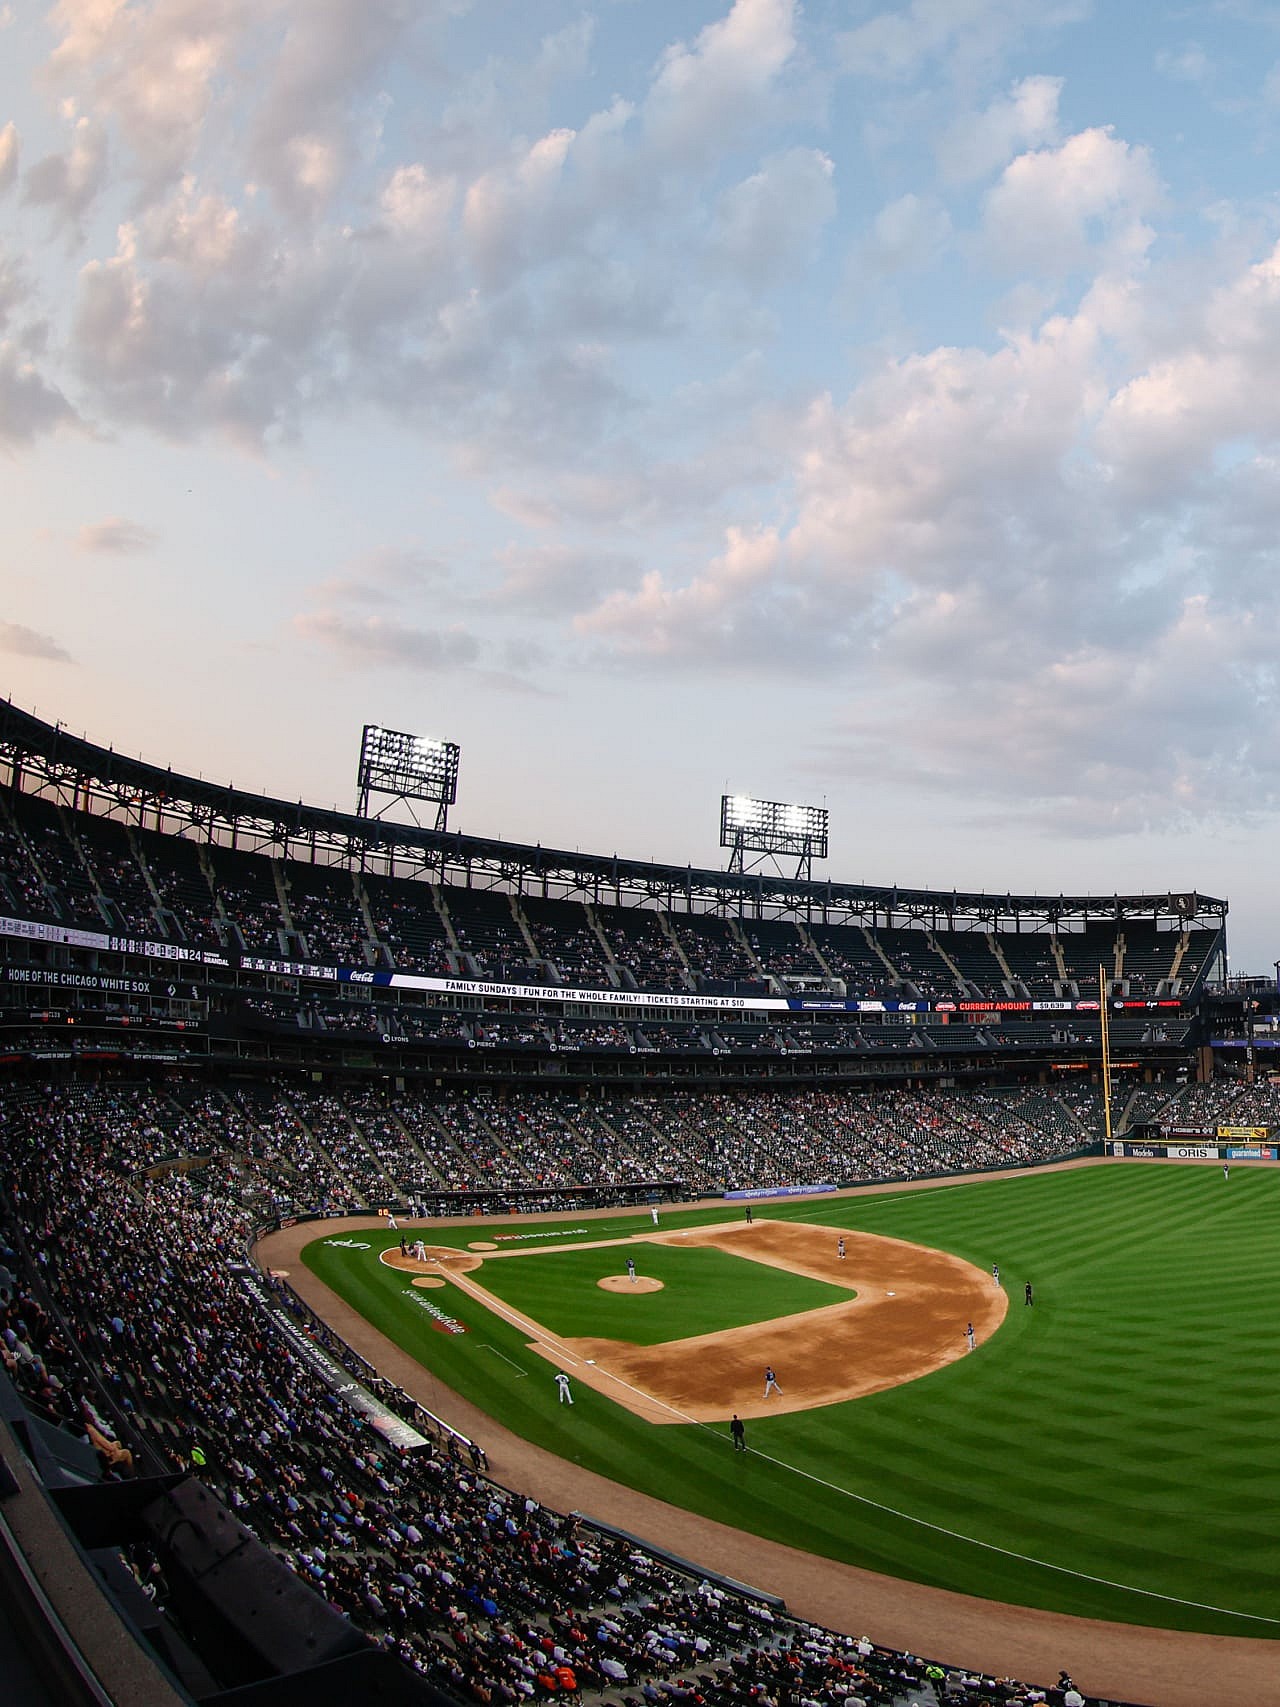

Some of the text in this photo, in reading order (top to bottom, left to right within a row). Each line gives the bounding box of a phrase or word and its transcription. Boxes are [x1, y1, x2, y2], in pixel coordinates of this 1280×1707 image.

[189, 949, 200, 961] 24
[9, 969, 150, 992] HOME OF THE CHICAGO WHITE SOX
[350, 971, 374, 982] Coca-Cola
[446, 982, 476, 991] FAMILY
[478, 984, 517, 995] SUNDAYS
[524, 988, 540, 996] FUN
[542, 989, 558, 998] FOR
[579, 992, 606, 1000] WHOLE
[647, 996, 679, 1004] TICKETS
[681, 998, 718, 1006] STARTING
[1178, 1149, 1208, 1158] ORIS
